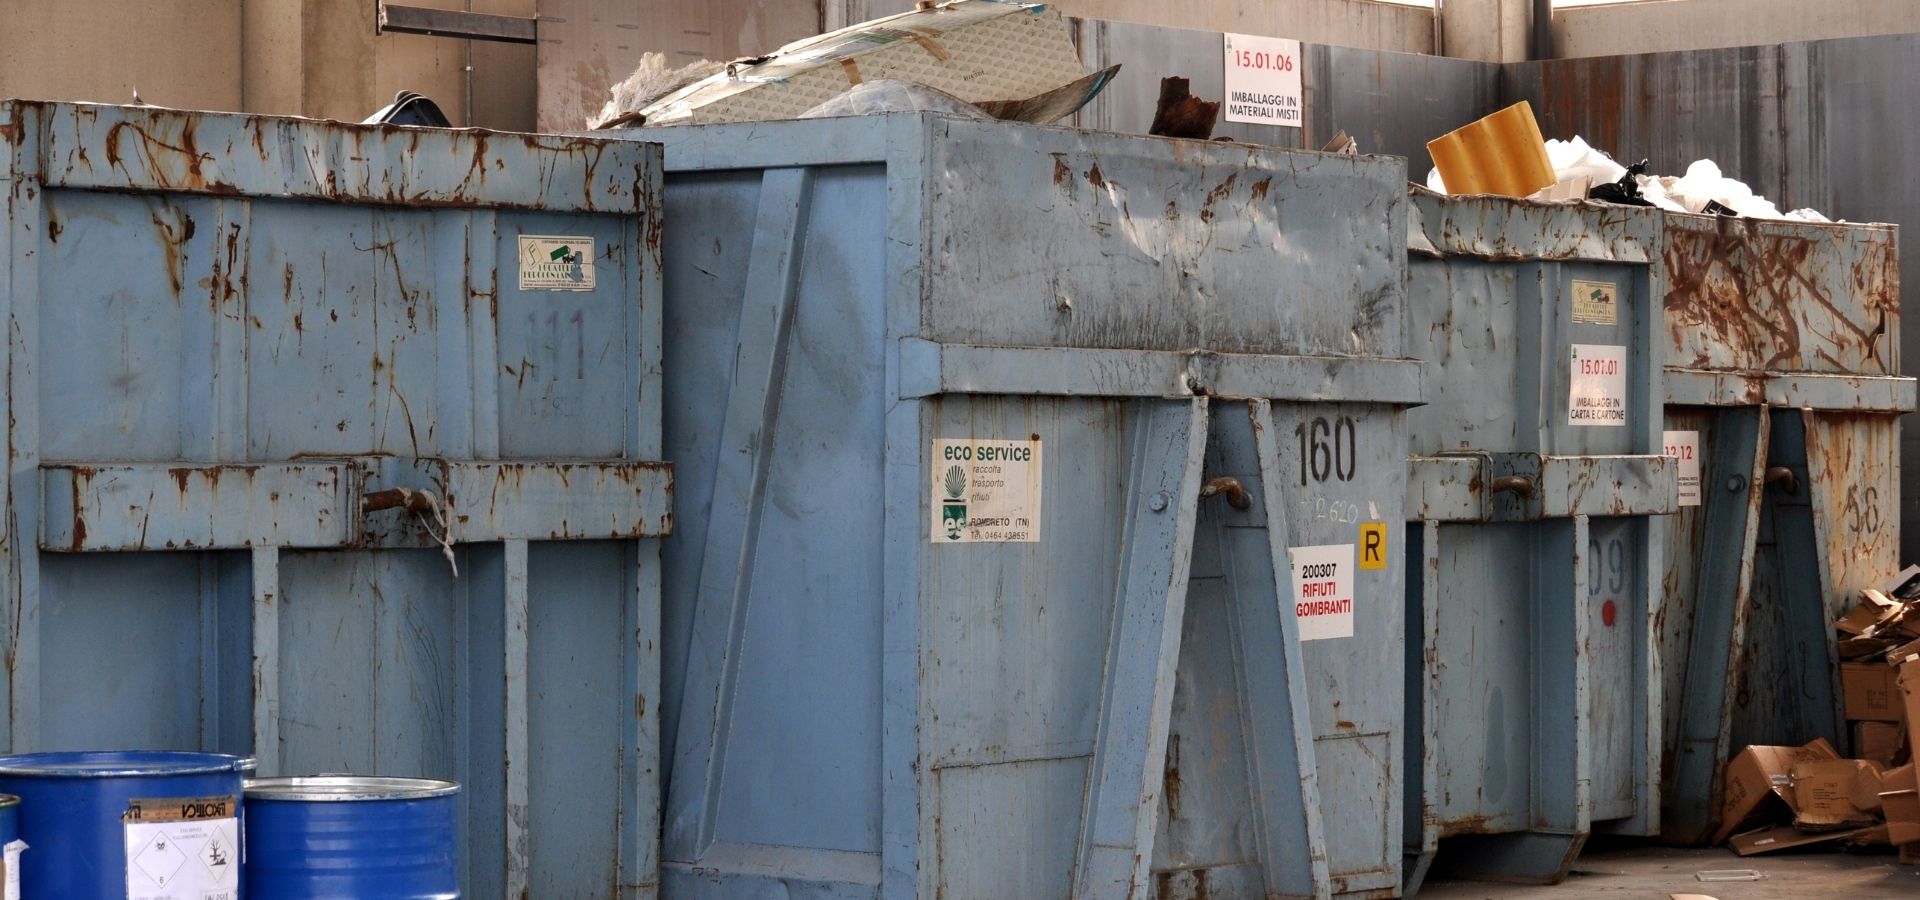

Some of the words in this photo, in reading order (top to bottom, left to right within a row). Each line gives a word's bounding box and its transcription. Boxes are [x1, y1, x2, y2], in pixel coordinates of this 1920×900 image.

[1235, 50, 1293, 72] 15.01.06
[1231, 91, 1284, 106] IMBALLAGGI
[1286, 96, 1297, 107] IN
[1229, 104, 1274, 118] MATERIALI
[1276, 108, 1299, 121] MISTI
[1580, 359, 1617, 375] 15.01.01
[1576, 397, 1612, 408] IMBALLAGGI
[1613, 398, 1620, 408] IN
[1570, 409, 1590, 419] CARTA
[1592, 410, 1596, 419] E
[1597, 410, 1624, 420] CARTONE
[944, 445, 972, 461] eco
[977, 443, 1031, 461] service
[1295, 415, 1356, 487] 160
[972, 465, 1002, 474] raccolta
[971, 478, 1004, 489] trasporto
[1015, 518, 1030, 528] (TN)
[985, 531, 1002, 540] 0464
[1364, 530, 1381, 562] R
[1302, 563, 1337, 579] 200307
[1302, 581, 1336, 598] RIFIUTI
[1296, 599, 1351, 617] GOMBRANTI
